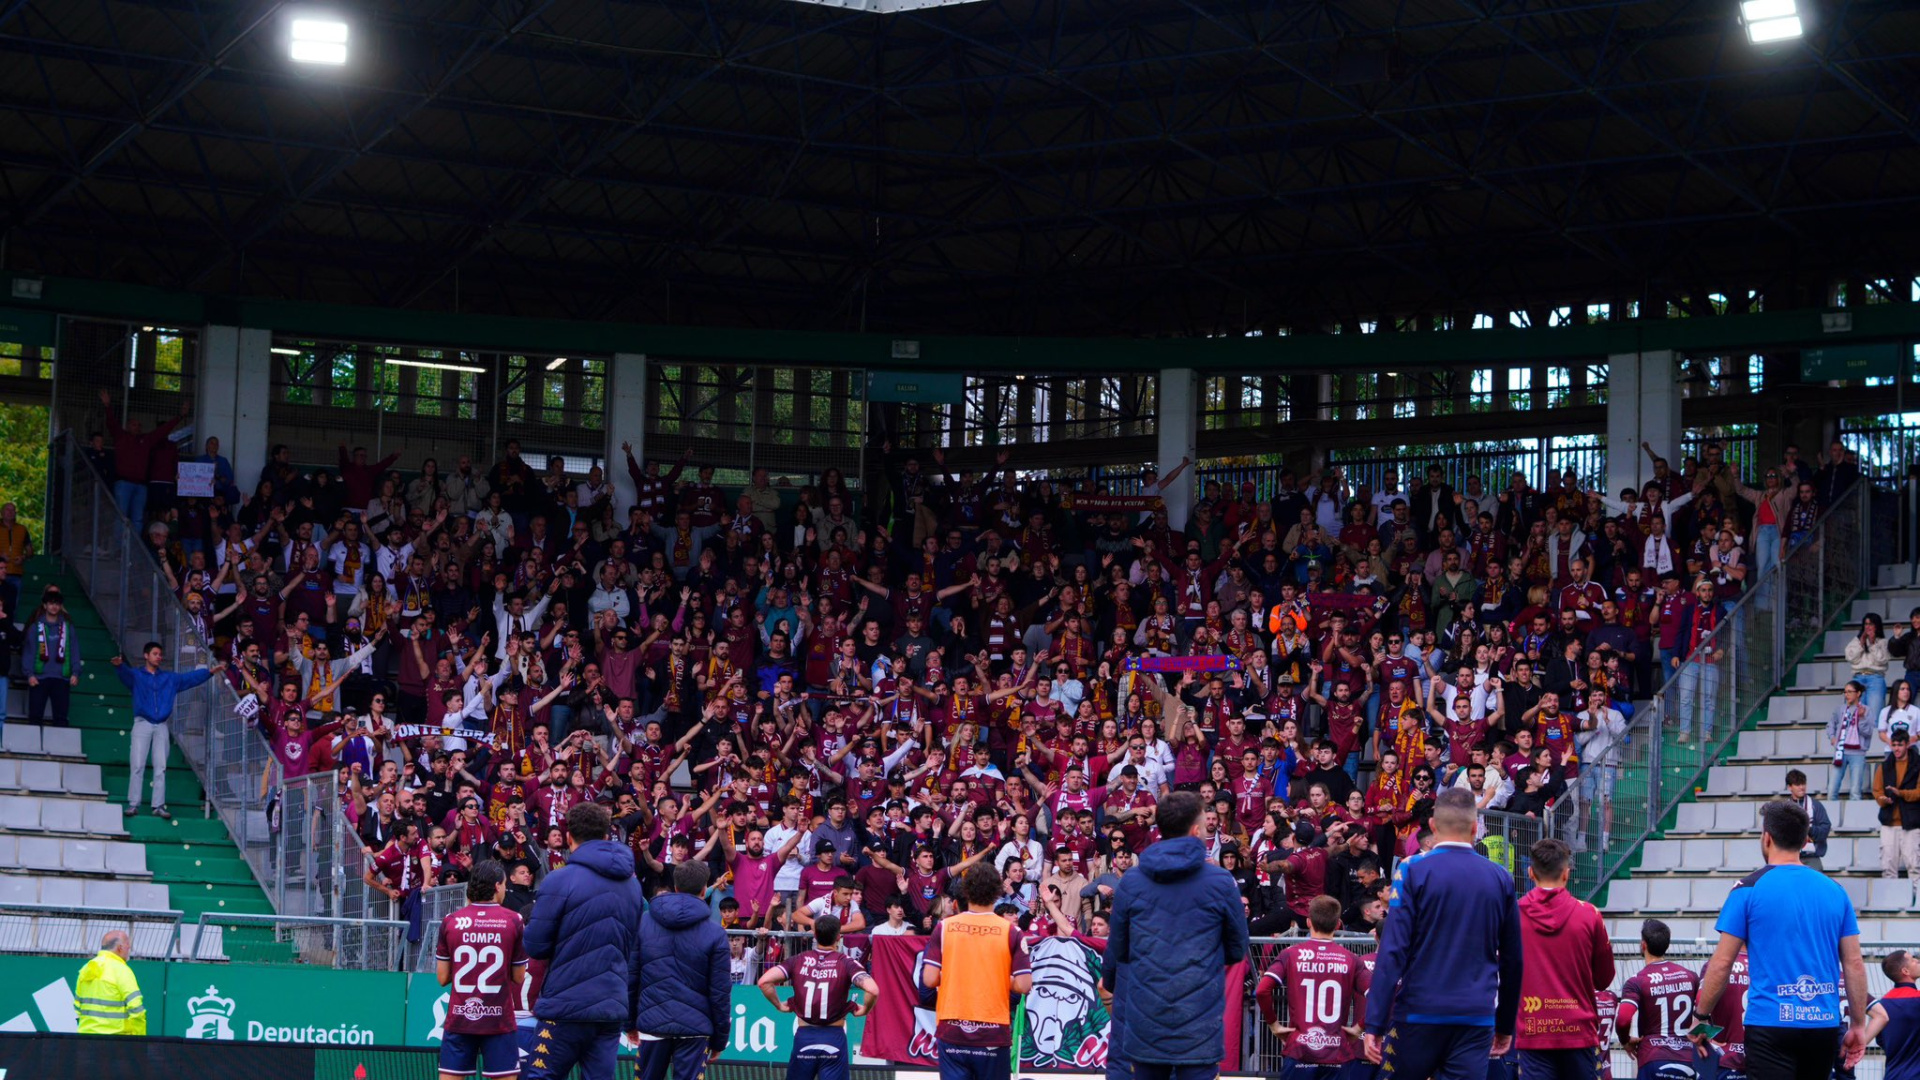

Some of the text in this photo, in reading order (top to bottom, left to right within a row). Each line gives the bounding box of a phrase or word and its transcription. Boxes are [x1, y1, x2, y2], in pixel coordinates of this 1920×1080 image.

[947, 922, 1002, 936] Kappa
[462, 932, 502, 943] COMPA
[453, 945, 504, 994] 22
[800, 968, 838, 979] M. CUESTA
[1296, 962, 1349, 974] YELKO PINO
[1729, 974, 1738, 984] B.
[1649, 985, 1666, 997] FACU
[1777, 982, 1835, 996] PESCAMAR
[803, 980, 830, 1020] 11
[1300, 978, 1342, 1024] 10
[1795, 1005, 1821, 1013] XUNTA
[1537, 1018, 1565, 1026] XUNTA
[1655, 994, 1693, 1038] 12
[1807, 1012, 1835, 1021] GALICIA
[247, 1020, 374, 1045] Deputación
[1549, 1025, 1581, 1033] GALICIA
